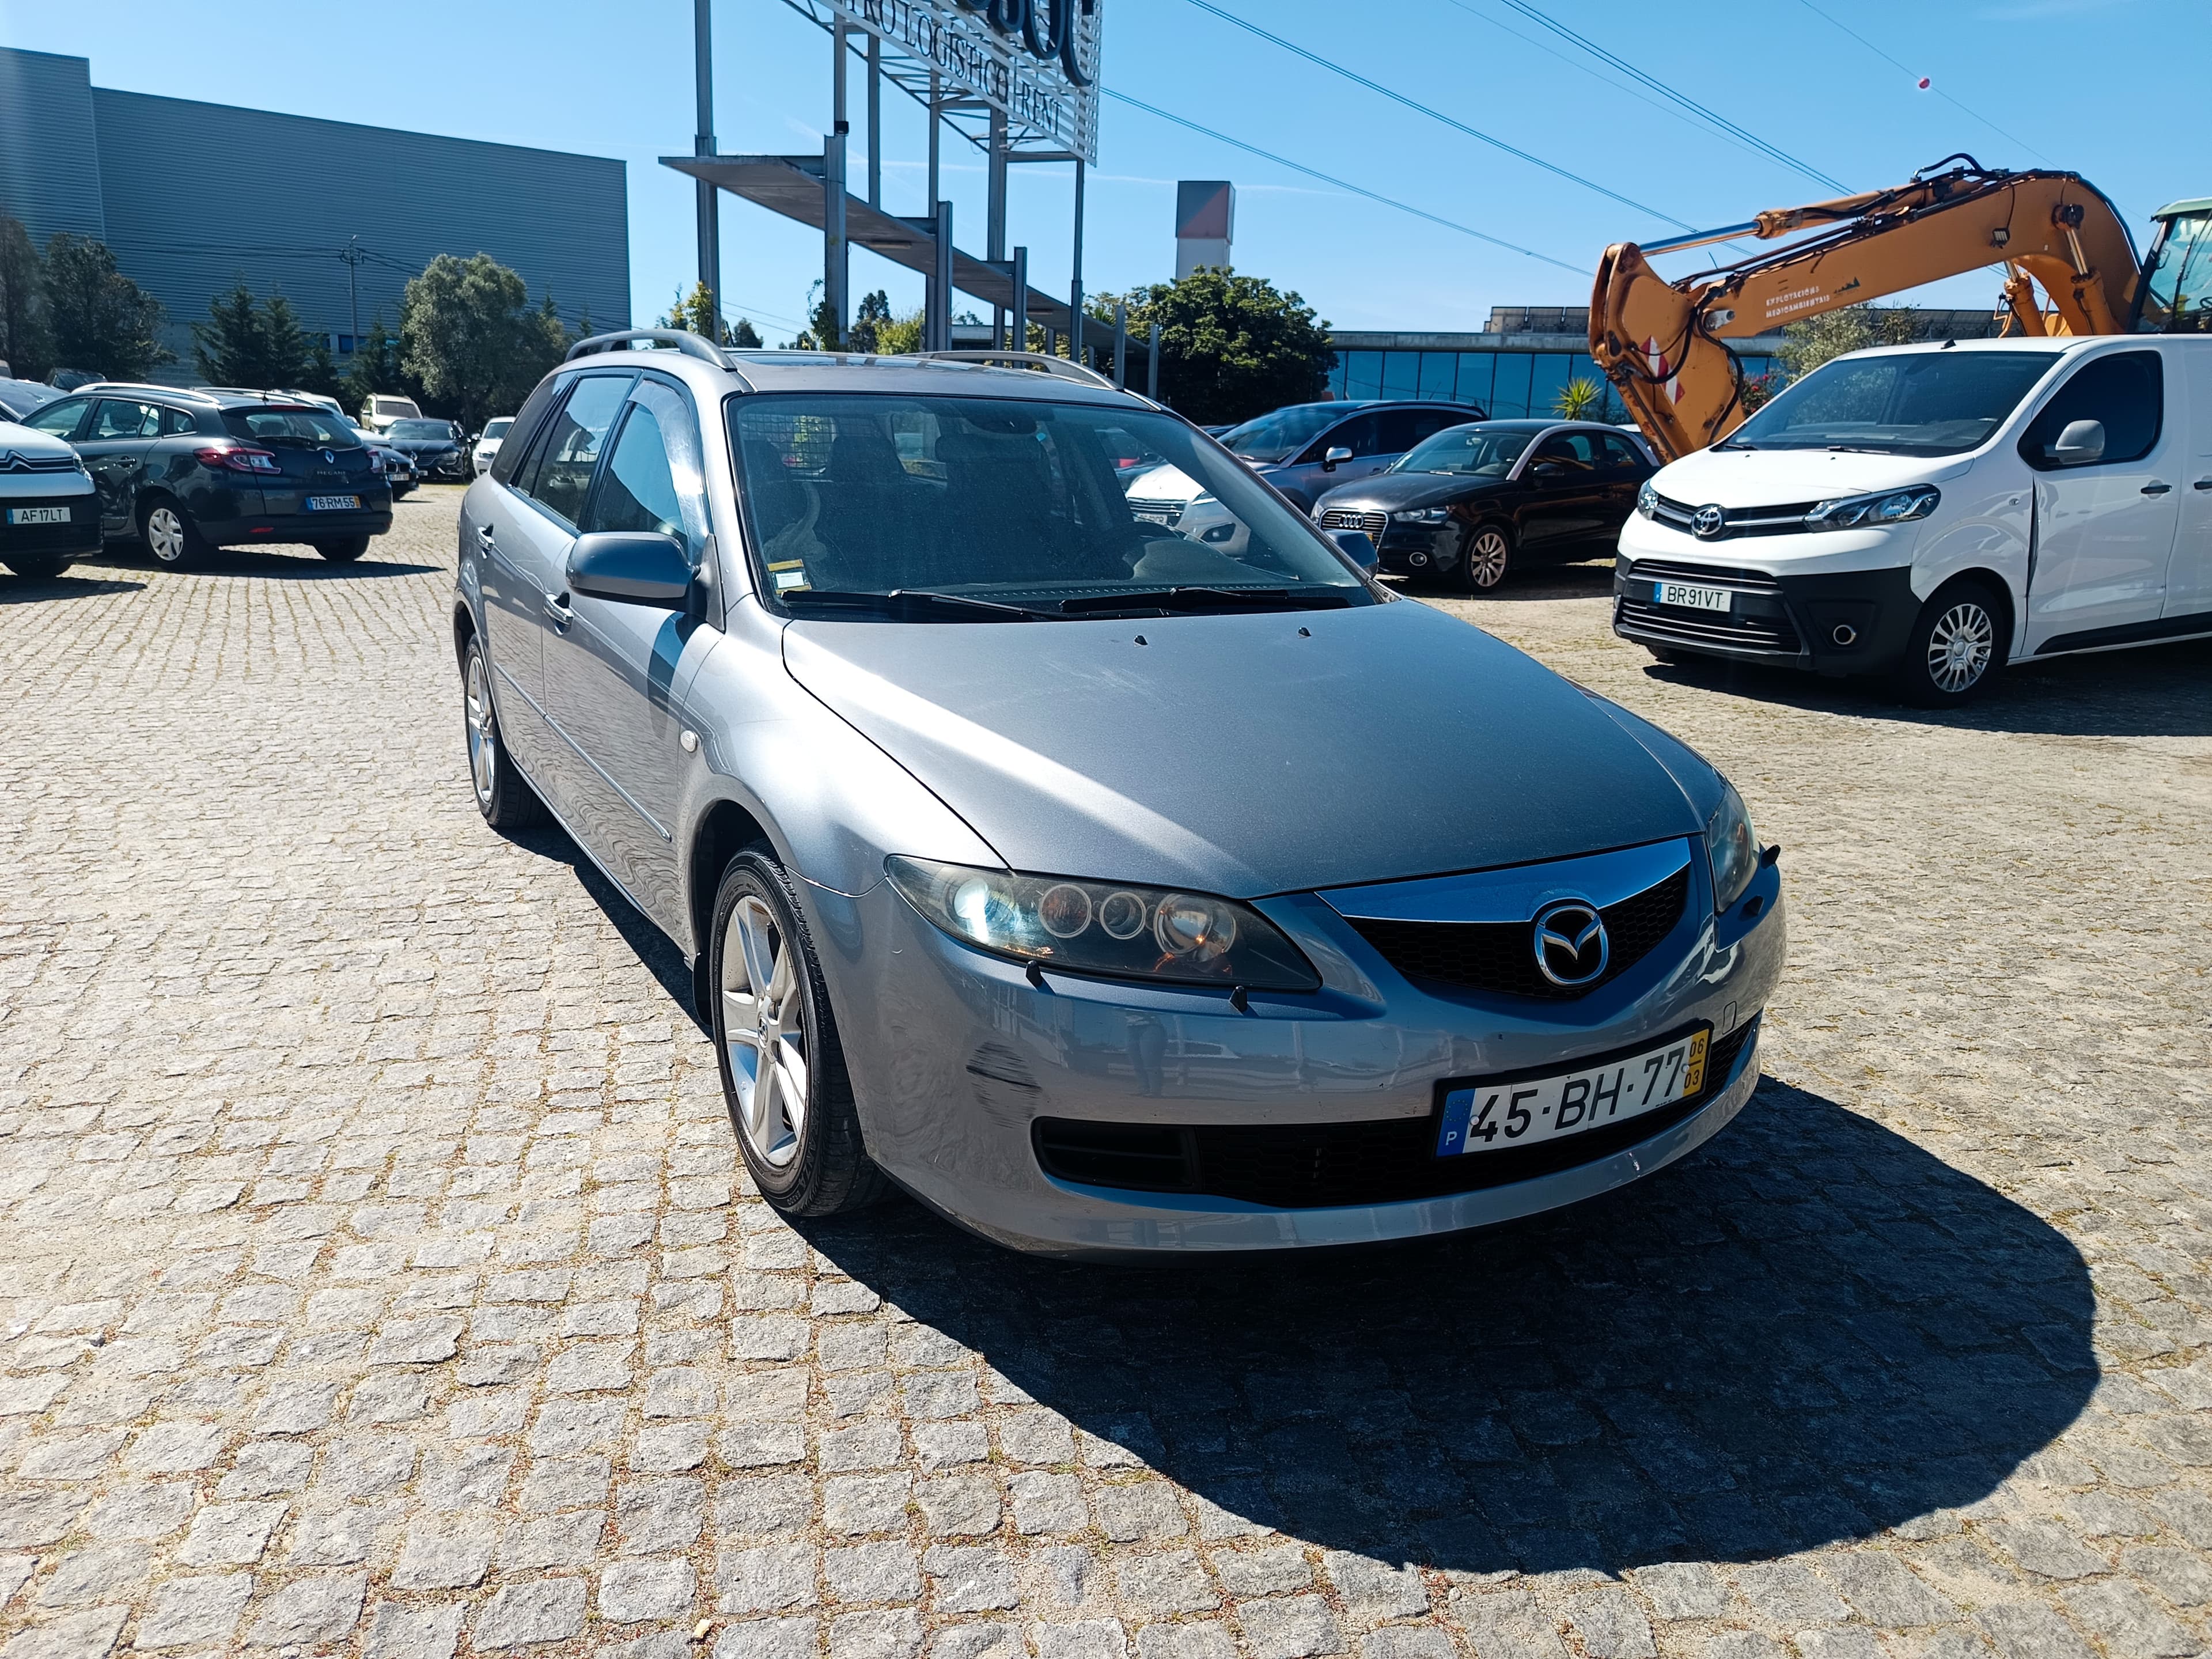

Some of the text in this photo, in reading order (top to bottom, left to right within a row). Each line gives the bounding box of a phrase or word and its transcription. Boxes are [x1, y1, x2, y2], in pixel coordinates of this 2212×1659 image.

[1690, 1038, 1705, 1058] 06
[1684, 1069, 1700, 1089] 03
[1446, 1131, 1457, 1146] P
